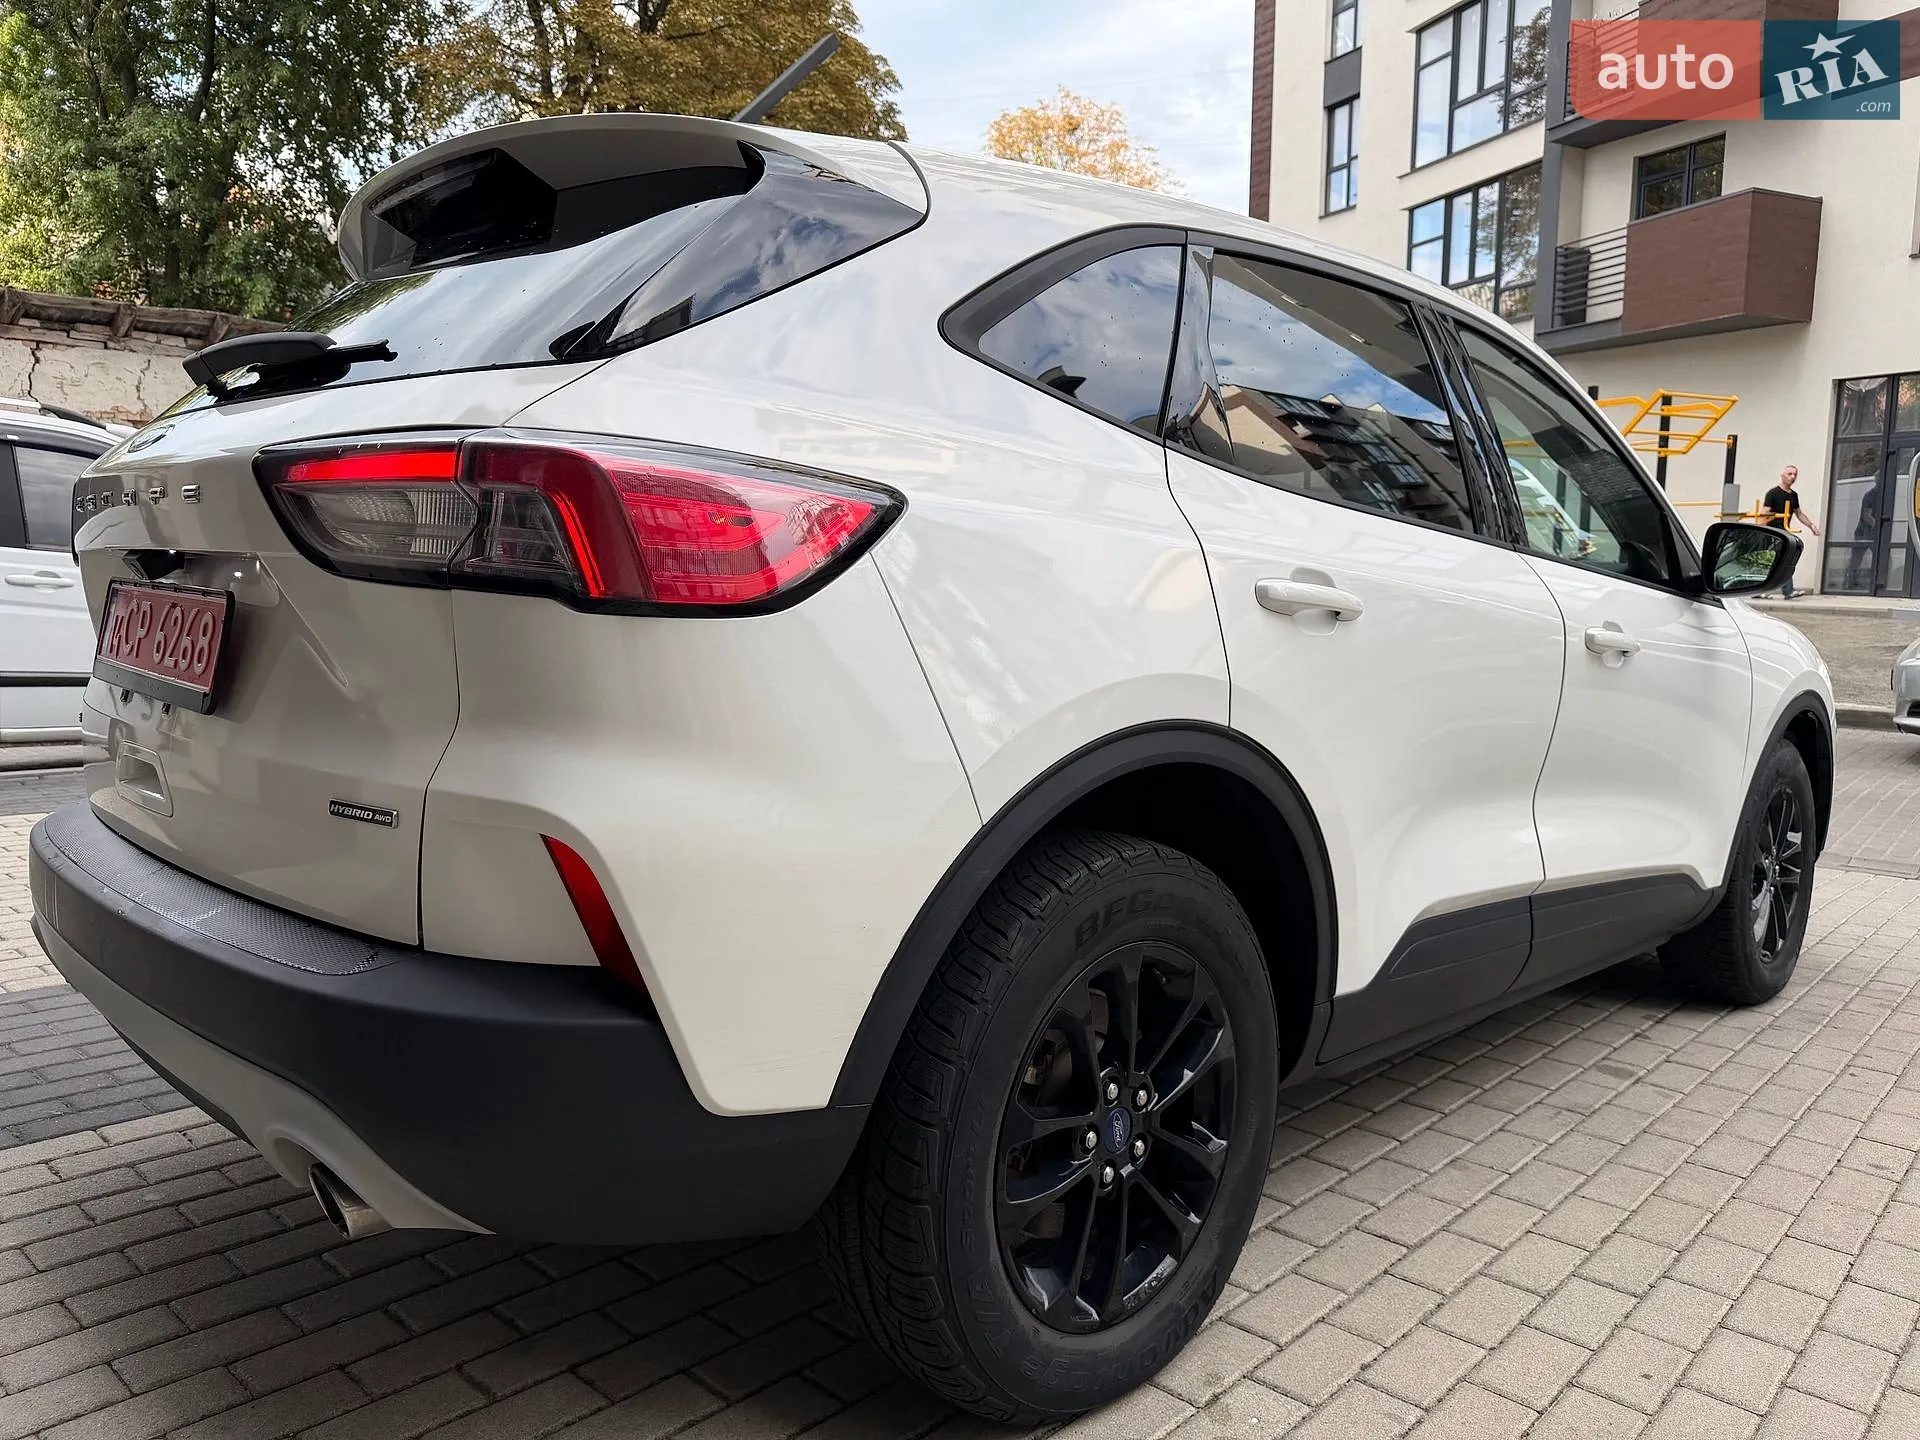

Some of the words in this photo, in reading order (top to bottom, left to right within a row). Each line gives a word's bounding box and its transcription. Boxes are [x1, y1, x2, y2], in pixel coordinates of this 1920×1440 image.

[152, 602, 216, 676] 6268
[330, 804, 373, 820] HYBRID
[374, 814, 392, 823] AWD
